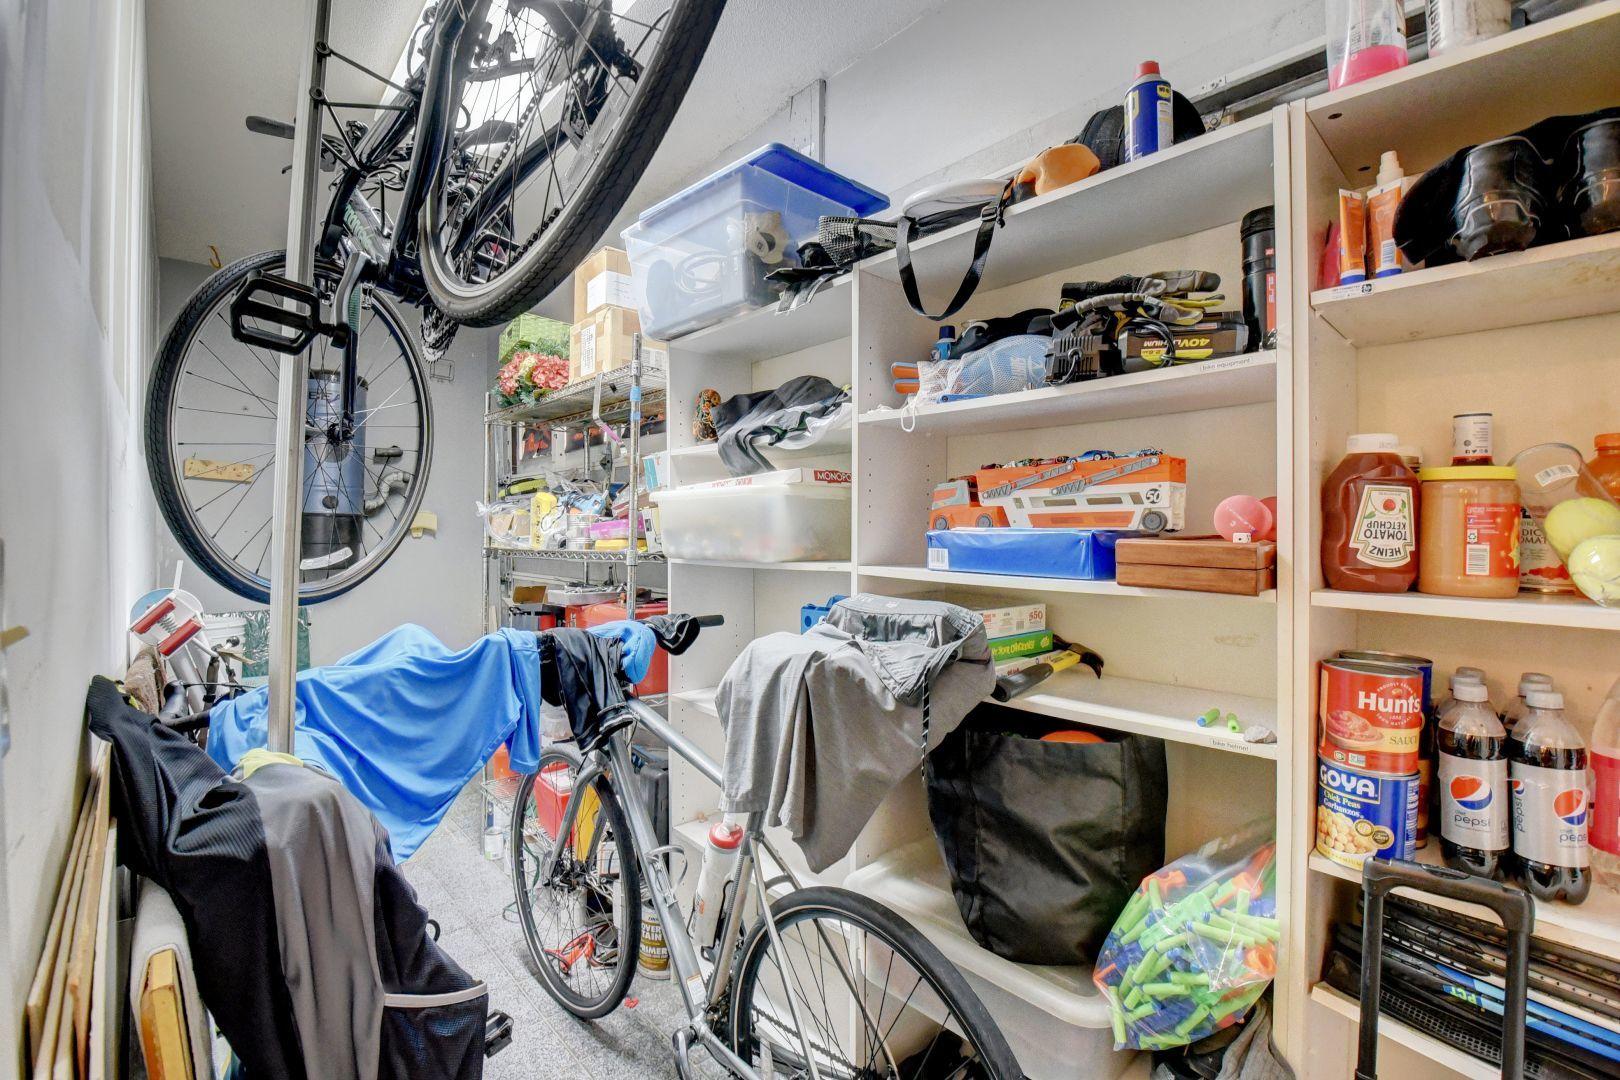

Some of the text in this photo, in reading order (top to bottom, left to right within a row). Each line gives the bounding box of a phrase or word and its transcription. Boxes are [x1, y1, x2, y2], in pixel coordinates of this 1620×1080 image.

[1143, 339, 1181, 348] LIHIUM
[817, 471, 852, 482] MONOPO
[1367, 520, 1406, 530] KETCHUP
[1364, 528, 1408, 541] TOMATO
[1521, 528, 1541, 537] DIC
[1369, 545, 1402, 557] HEINZ
[1320, 764, 1375, 798] GOYA
[1323, 790, 1361, 810] Chick Peas
[1323, 798, 1361, 819] Garbanzos
[1514, 797, 1526, 833] pepsi
[1454, 814, 1490, 828] pepsi
[1559, 833, 1587, 844] peps
[641, 922, 662, 933] OVER
[641, 930, 663, 941] TAIN
[640, 945, 668, 955] RIMER
